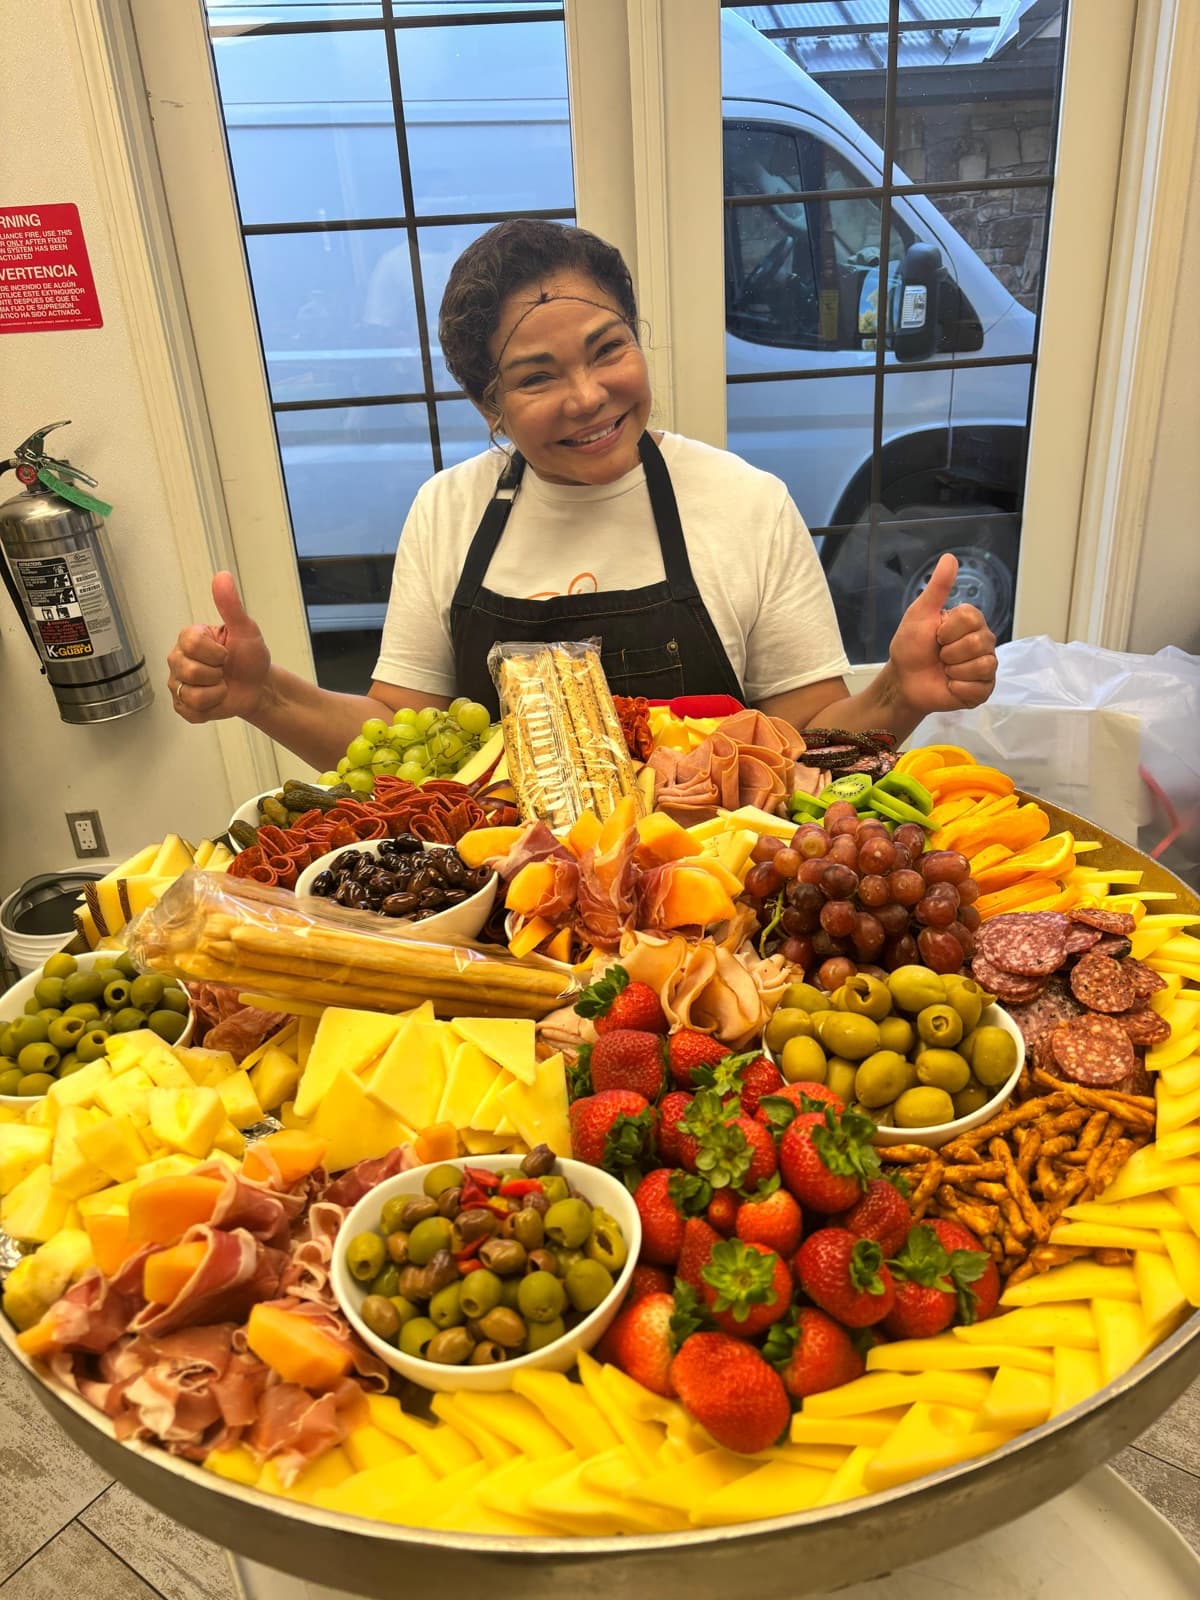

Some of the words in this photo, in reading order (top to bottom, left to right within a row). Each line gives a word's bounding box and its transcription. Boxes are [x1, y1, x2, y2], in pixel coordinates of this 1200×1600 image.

[25, 237, 47, 245] AFTER
[47, 236, 67, 244] FIXED
[6, 245, 34, 254] SYSTEM
[10, 283, 42, 291] INCENDIO
[41, 288, 85, 296] EXTINGUIDOR
[55, 295, 71, 303] QUE
[71, 294, 81, 302] EL
[10, 304, 26, 312] FIJO
[20, 311, 31, 319] HA
[31, 310, 47, 318] SIDO
